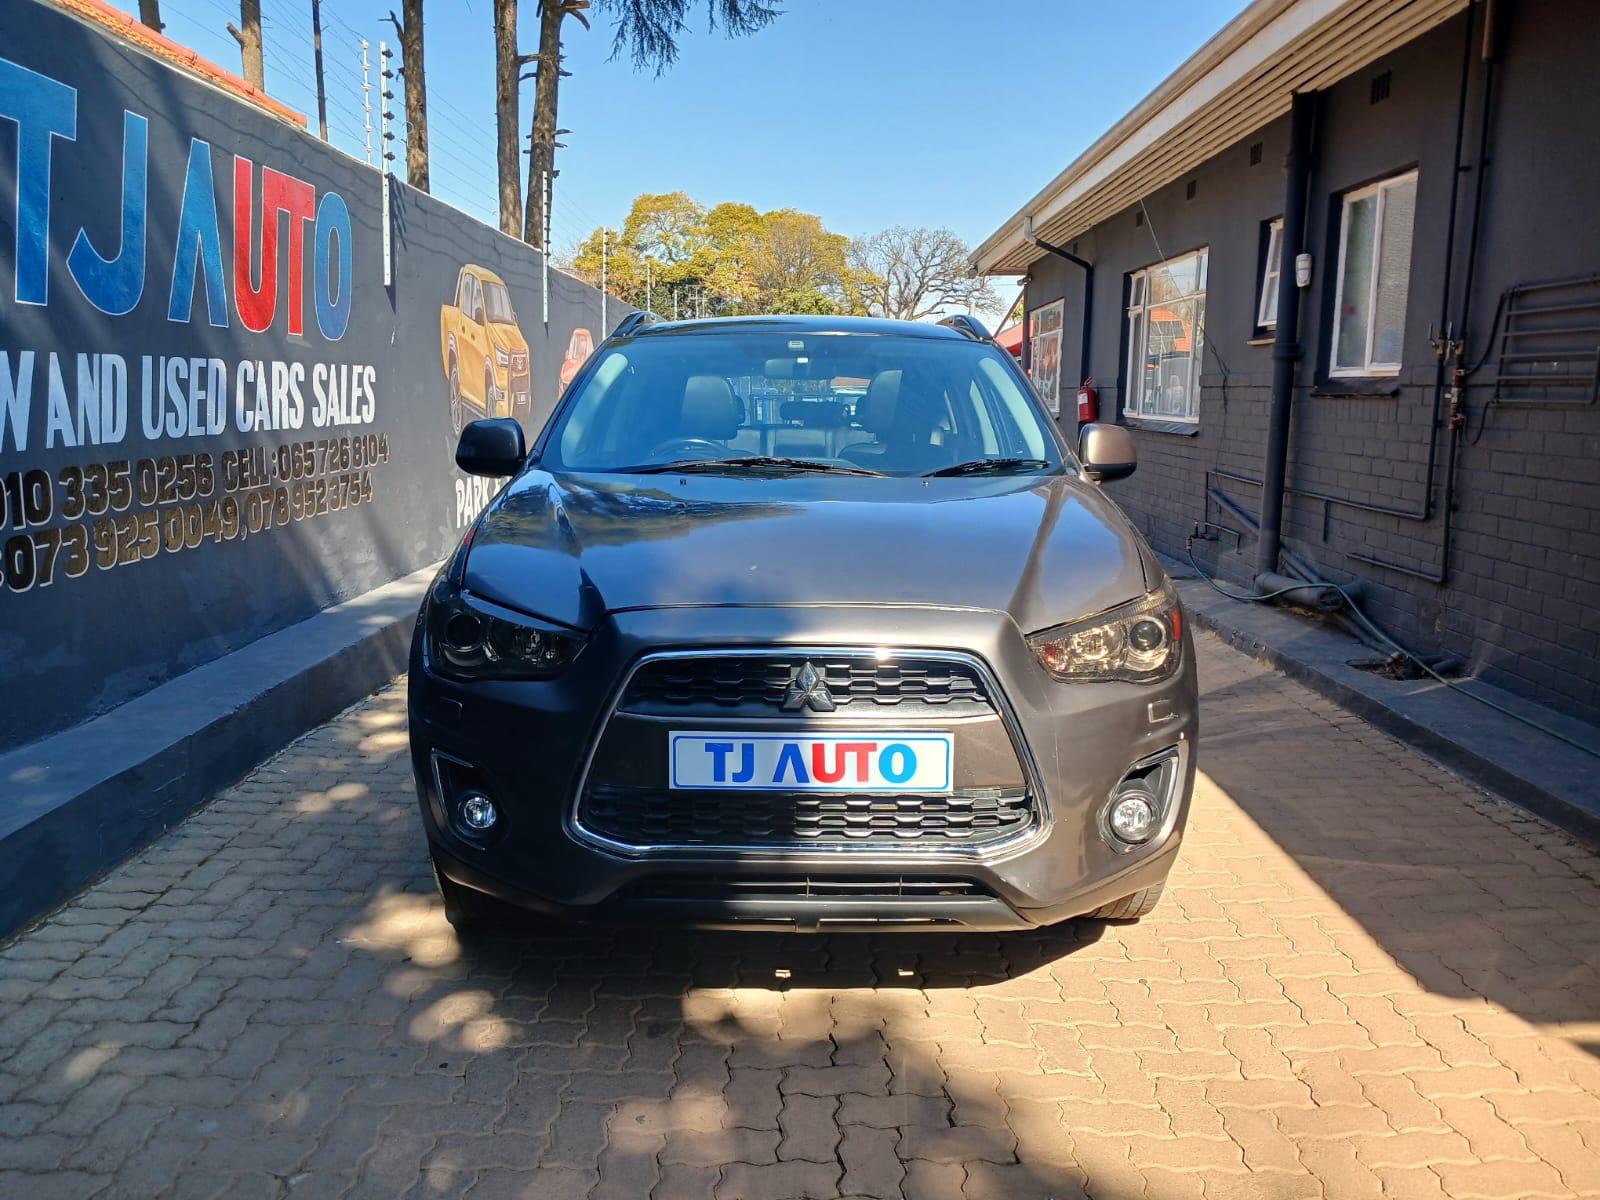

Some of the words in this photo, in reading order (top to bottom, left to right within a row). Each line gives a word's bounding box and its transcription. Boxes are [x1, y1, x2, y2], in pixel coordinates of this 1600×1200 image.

[167, 137, 352, 341] AUTO
[46, 351, 128, 449] AND
[141, 355, 227, 439] USED
[236, 360, 304, 432] CARS
[312, 362, 376, 428] SALES
[0, 469, 54, 531] 10
[58, 459, 133, 520] 335
[136, 453, 215, 507] 0256
[317, 436, 351, 475] 726
[351, 432, 390, 470] 8104
[94, 509, 160, 571] 925
[291, 477, 329, 523] 952
[328, 469, 374, 512] 3754
[704, 742, 755, 783] TJ
[772, 742, 917, 784] AUTO
